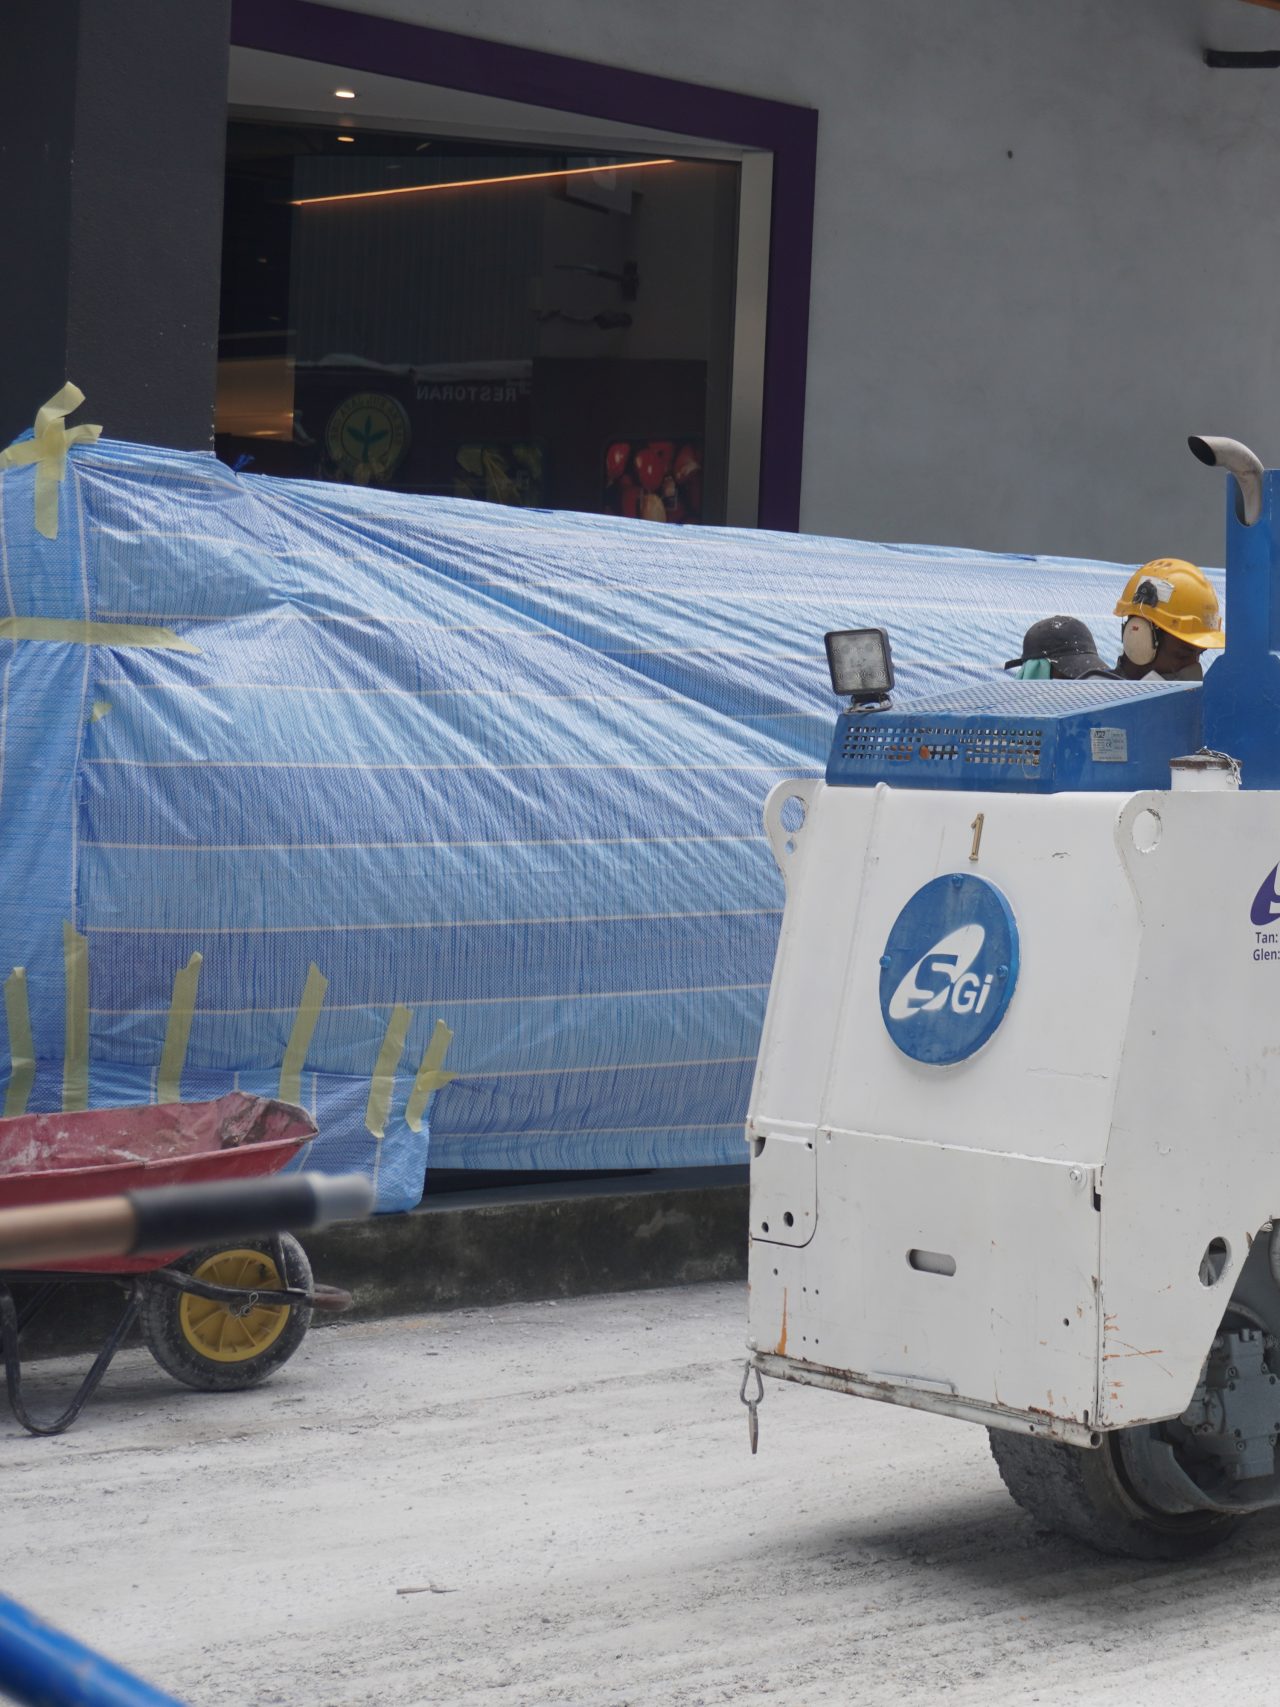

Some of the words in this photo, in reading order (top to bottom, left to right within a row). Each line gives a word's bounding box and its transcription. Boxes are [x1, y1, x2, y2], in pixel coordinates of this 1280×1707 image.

[969, 813, 985, 862] 1
[1255, 931, 1279, 944] Tan:
[1253, 947, 1280, 961] Glen:
